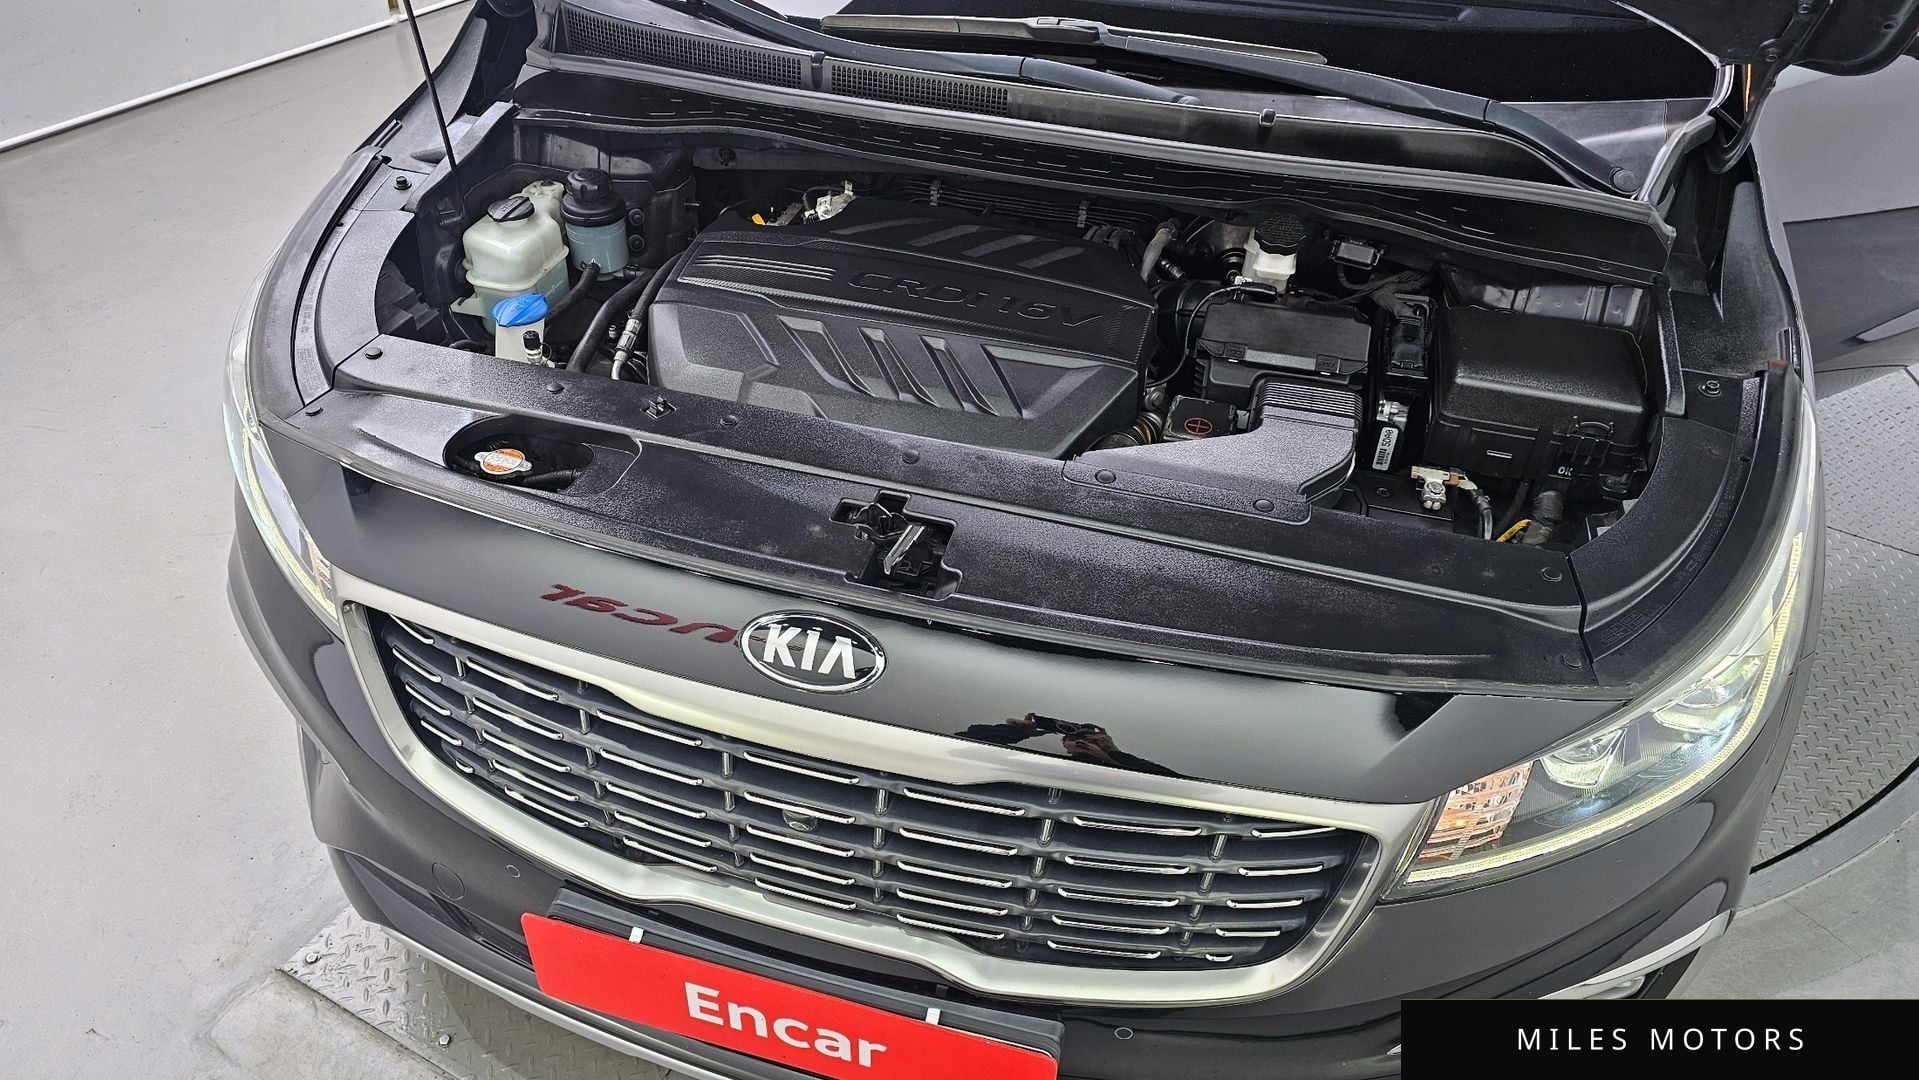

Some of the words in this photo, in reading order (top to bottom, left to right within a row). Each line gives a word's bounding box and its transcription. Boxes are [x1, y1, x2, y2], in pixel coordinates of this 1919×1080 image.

[1557, 465, 1574, 477] OK
[762, 623, 857, 680] KIA
[683, 981, 888, 1068] Encar
